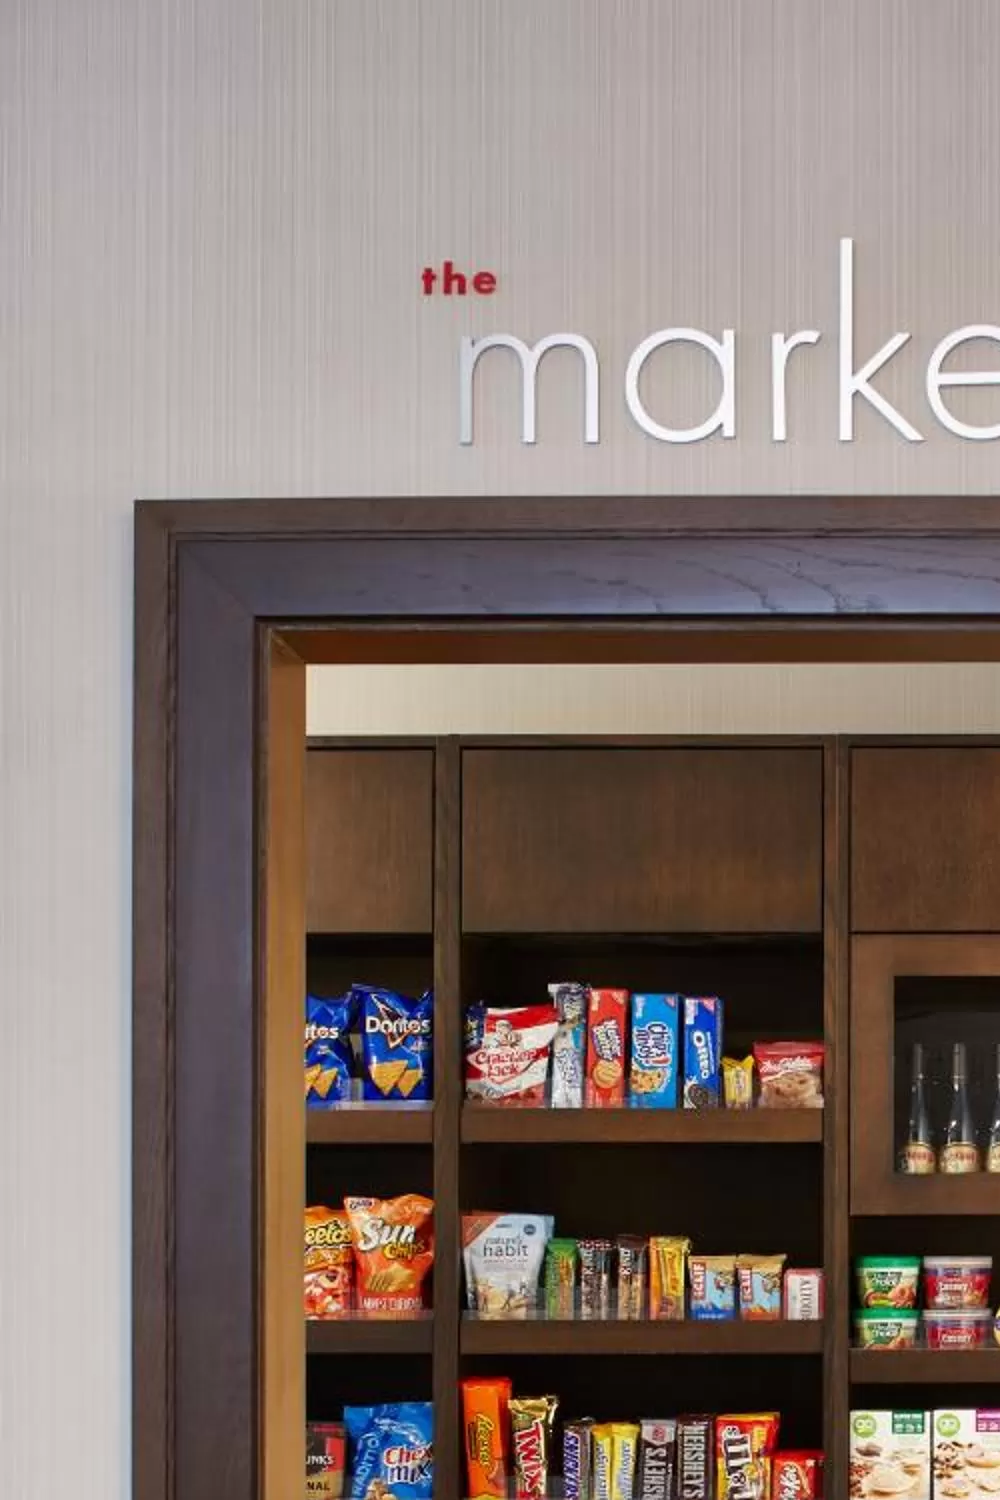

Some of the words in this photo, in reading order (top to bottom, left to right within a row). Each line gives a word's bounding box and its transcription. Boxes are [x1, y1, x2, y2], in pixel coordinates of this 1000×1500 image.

[422, 262, 497, 296] the
[365, 1016, 431, 1034] Doritos
[483, 1239, 529, 1257] habit
[514, 1420, 545, 1494] TWIX
